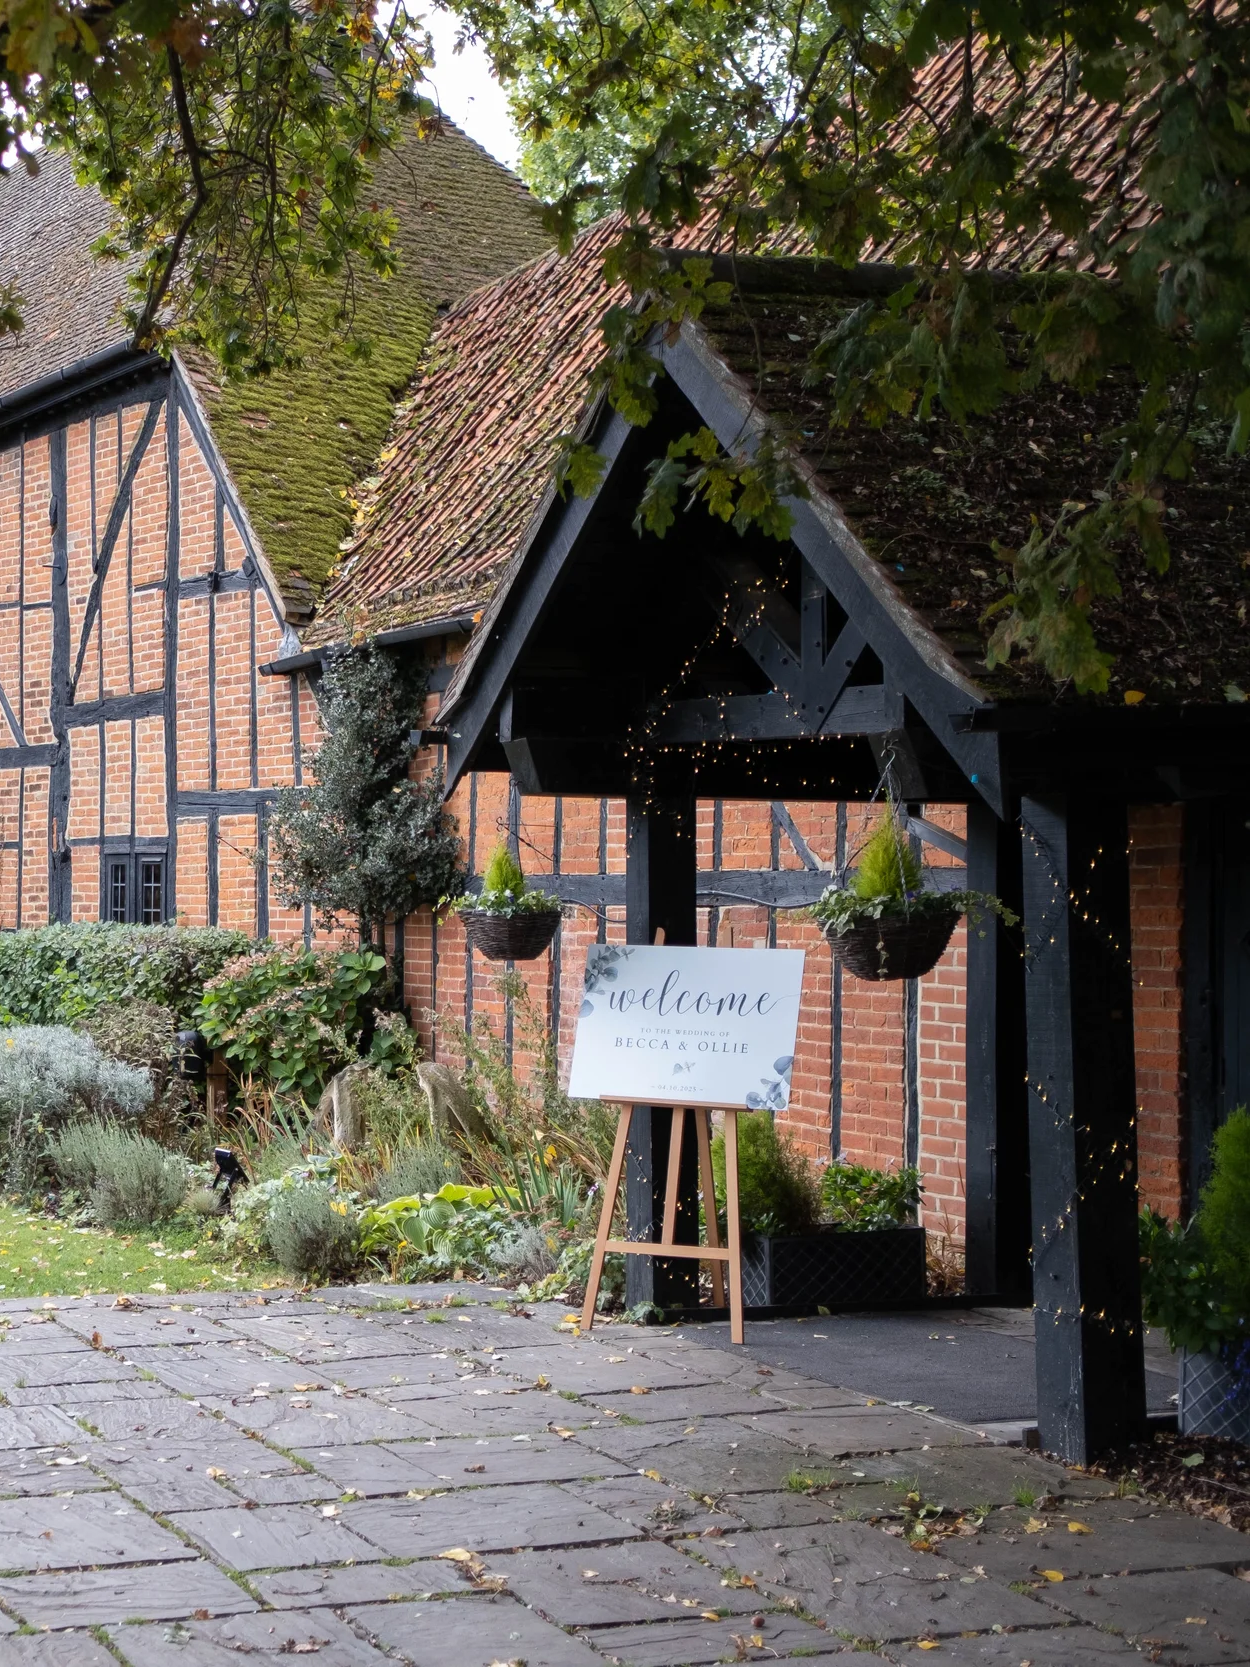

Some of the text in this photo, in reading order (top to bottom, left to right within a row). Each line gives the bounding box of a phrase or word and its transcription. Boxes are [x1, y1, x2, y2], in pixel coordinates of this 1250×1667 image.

[609, 970, 800, 1017] welcome
[675, 1029, 716, 1037] WEDDING
[614, 1037, 749, 1054] BECCA & OLLIE
